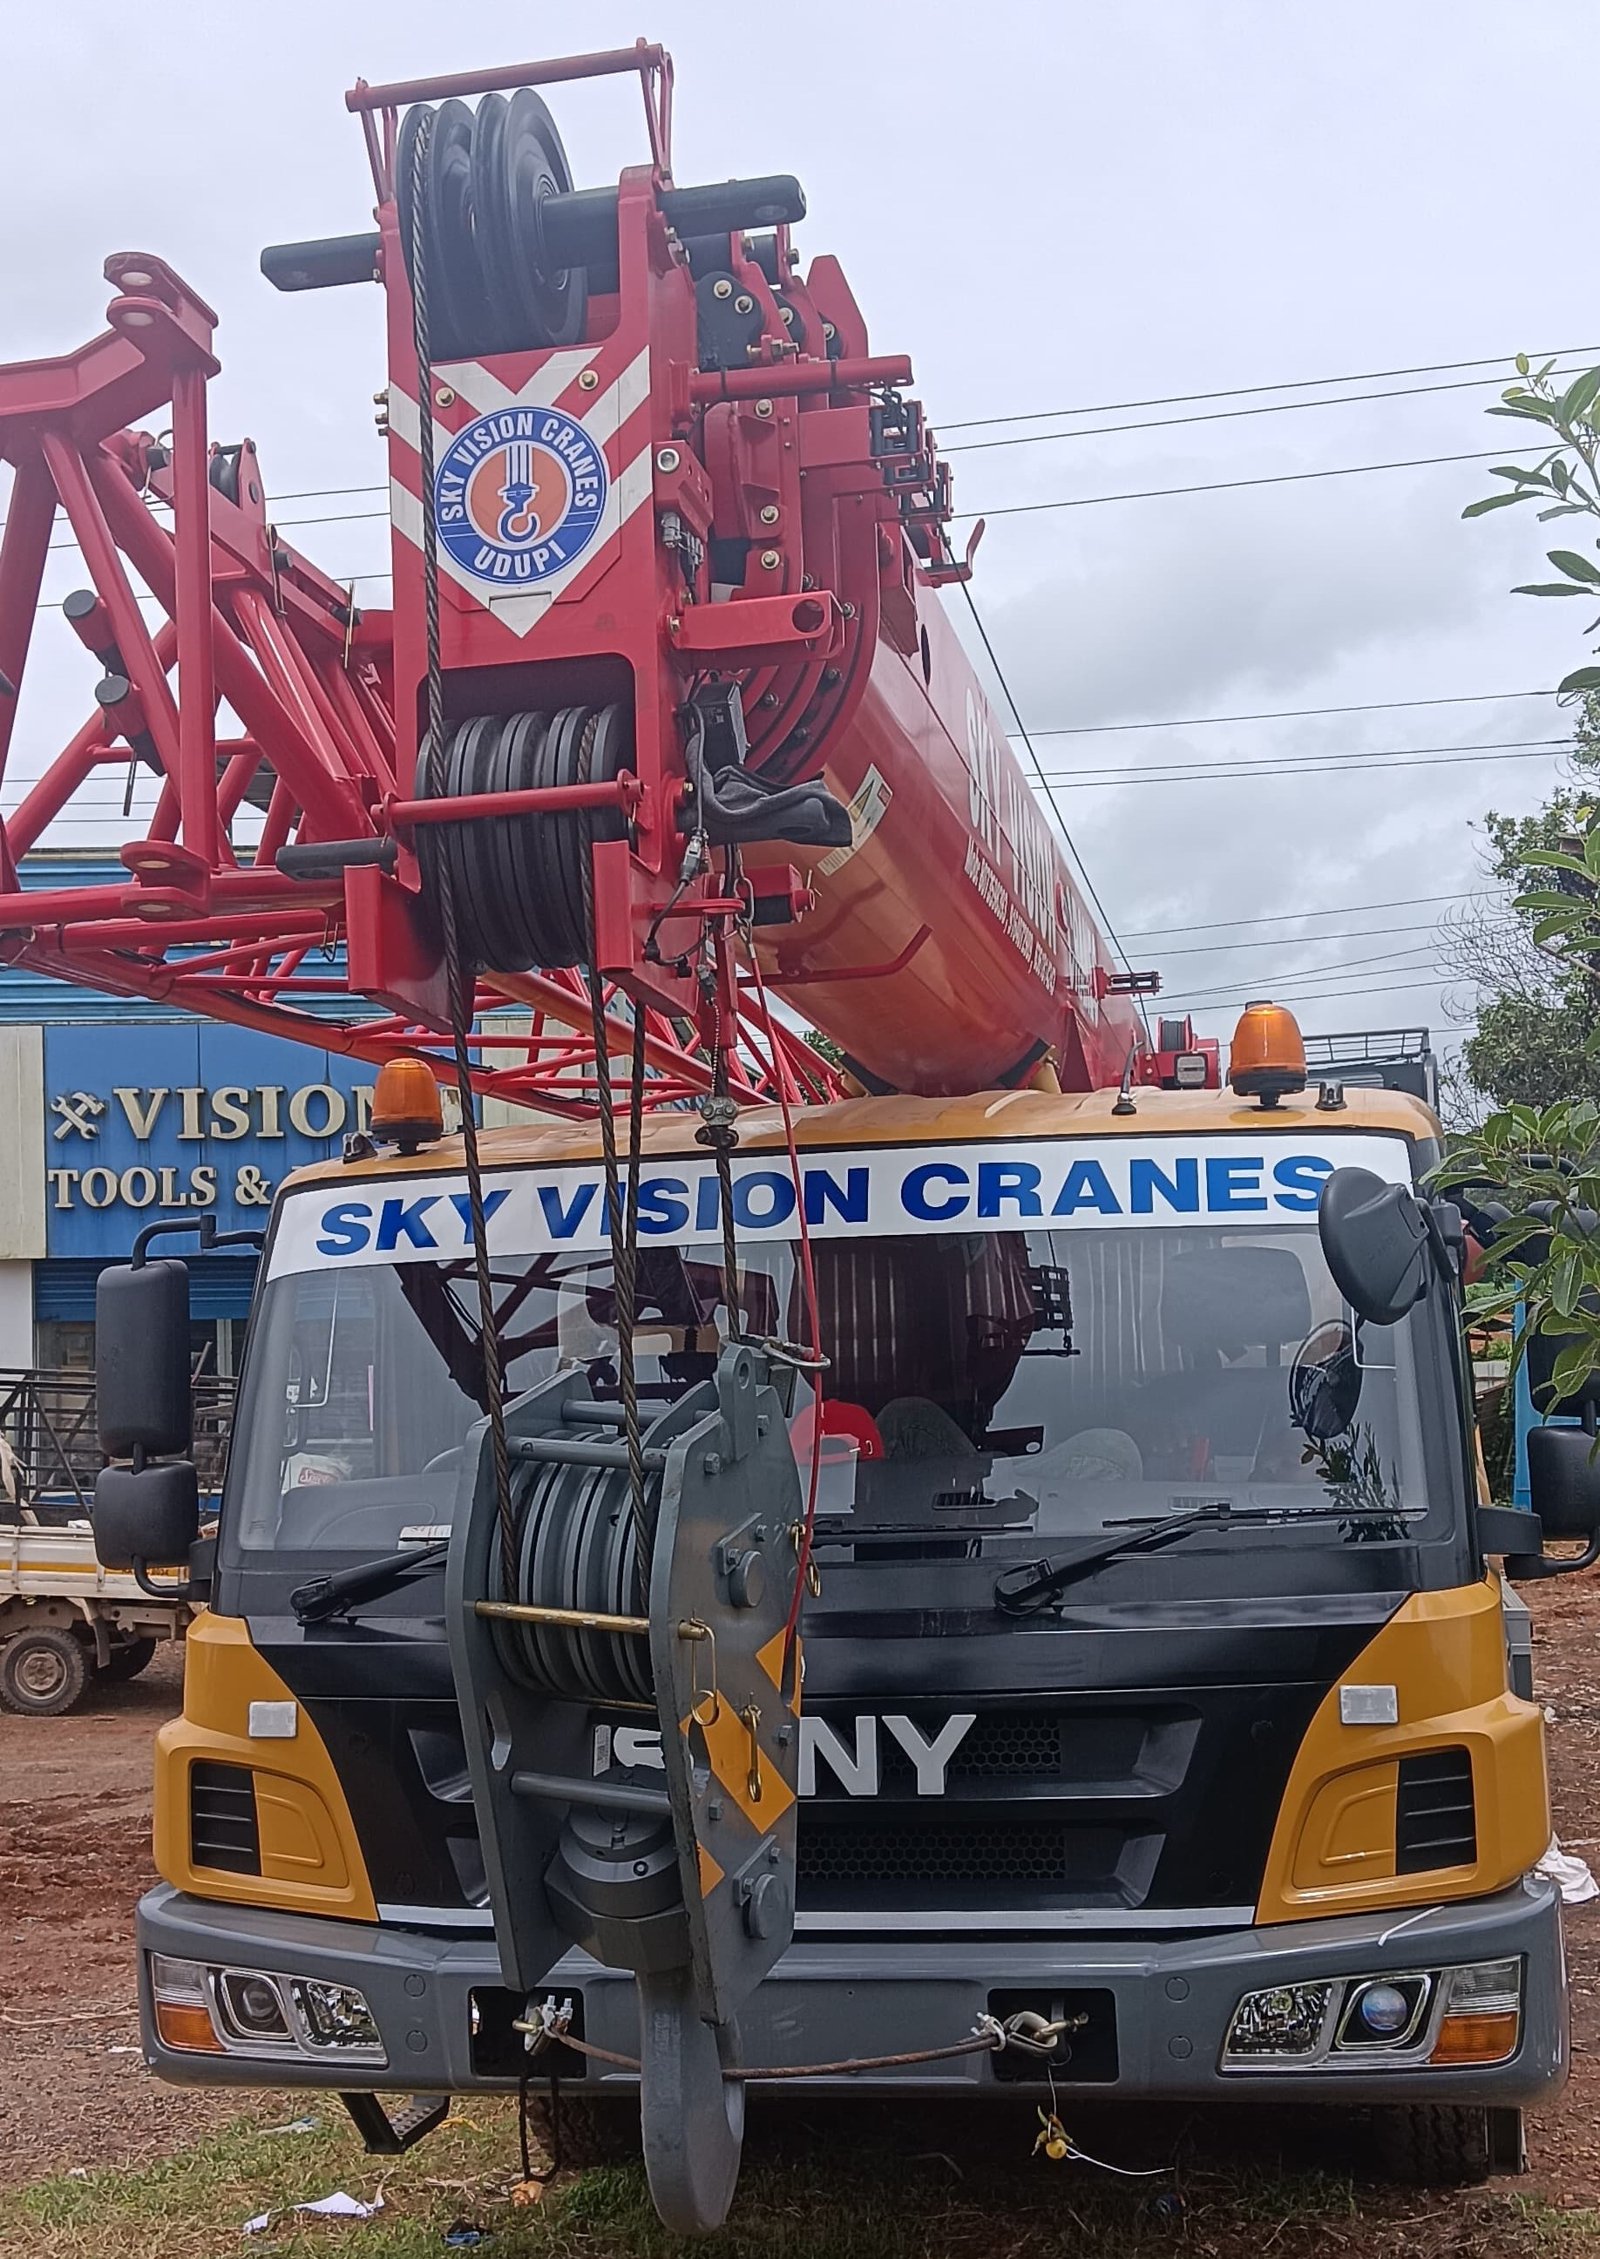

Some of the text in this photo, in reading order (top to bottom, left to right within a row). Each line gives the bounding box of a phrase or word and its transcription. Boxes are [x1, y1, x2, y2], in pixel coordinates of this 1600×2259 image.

[441, 412, 598, 521] SKY VISION CRANES
[473, 541, 567, 577] UDUPI
[966, 687, 1001, 866] SKY
[1006, 768, 1057, 956] VISION
[48, 1165, 271, 1208] TOOLS &
[315, 1155, 1336, 1257] SKY VISION CRANES
